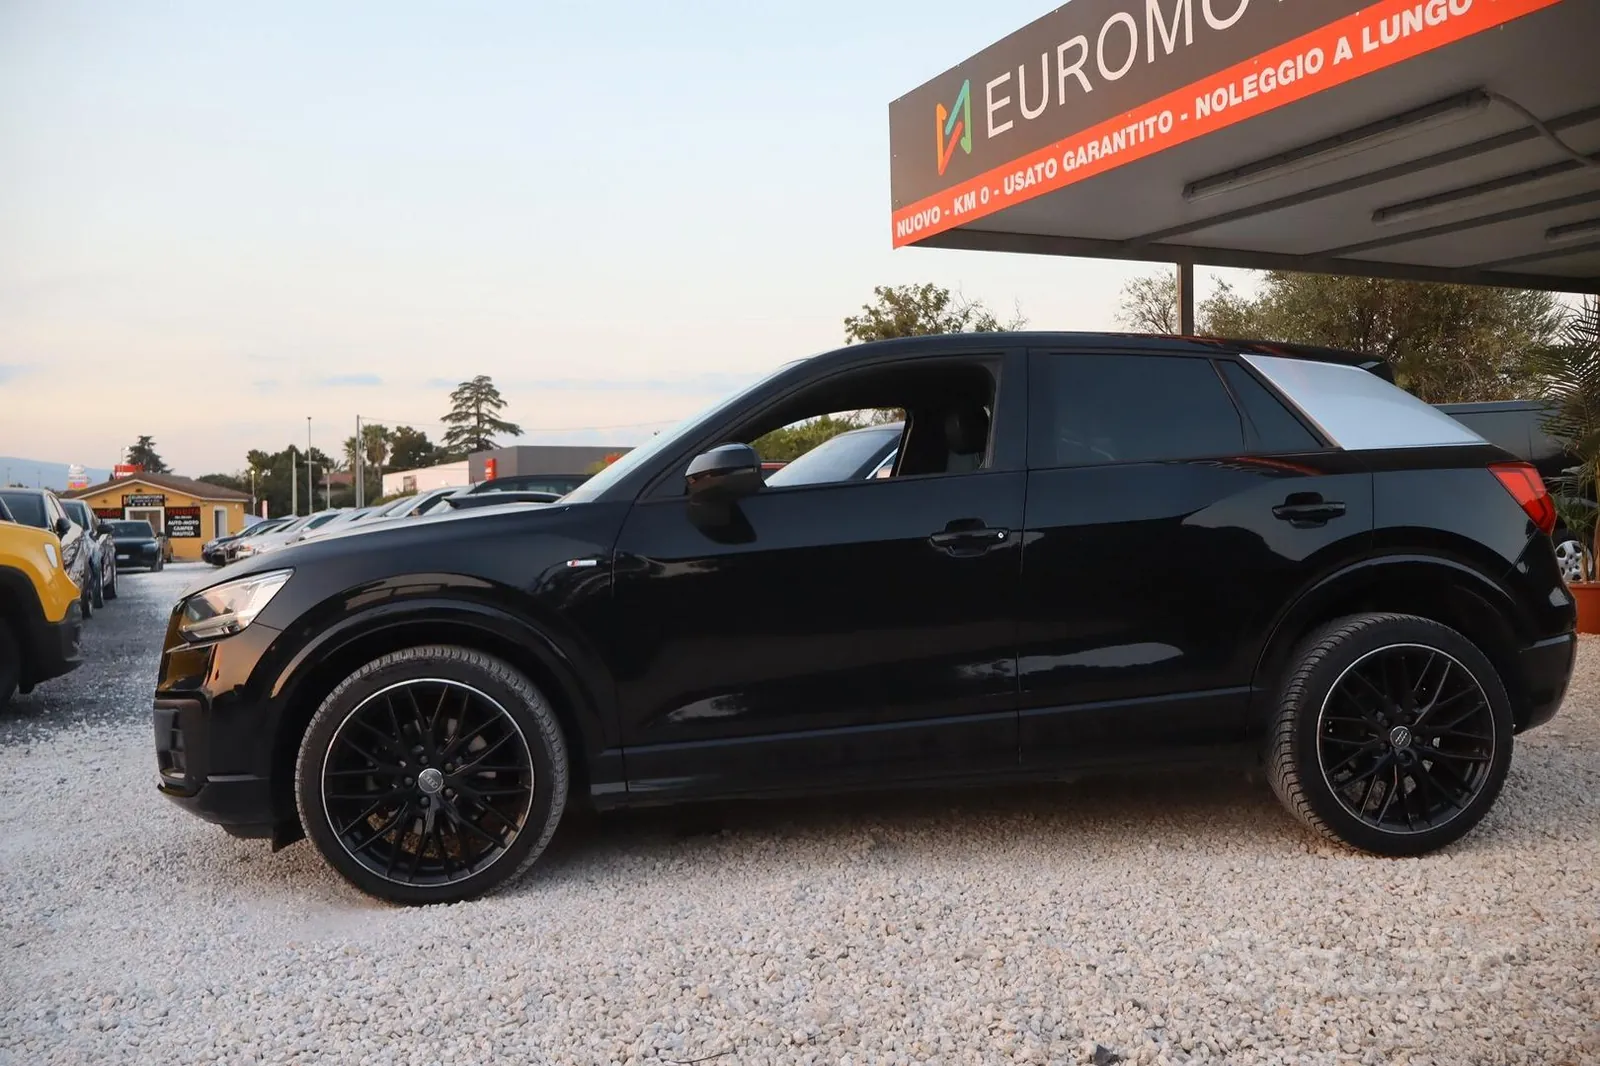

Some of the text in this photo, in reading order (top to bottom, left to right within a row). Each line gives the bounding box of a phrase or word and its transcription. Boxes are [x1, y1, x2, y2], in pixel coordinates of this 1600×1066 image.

[897, 205, 941, 238] NUOVO
[953, 190, 977, 216] KM
[980, 186, 990, 205] 0
[1004, 157, 1058, 196] USATO
[1062, 110, 1174, 173] GARANTITO
[1195, 47, 1325, 121] NOLEGGIO
[1333, 36, 1353, 66] A
[1362, 0, 1473, 54] LUNGO
